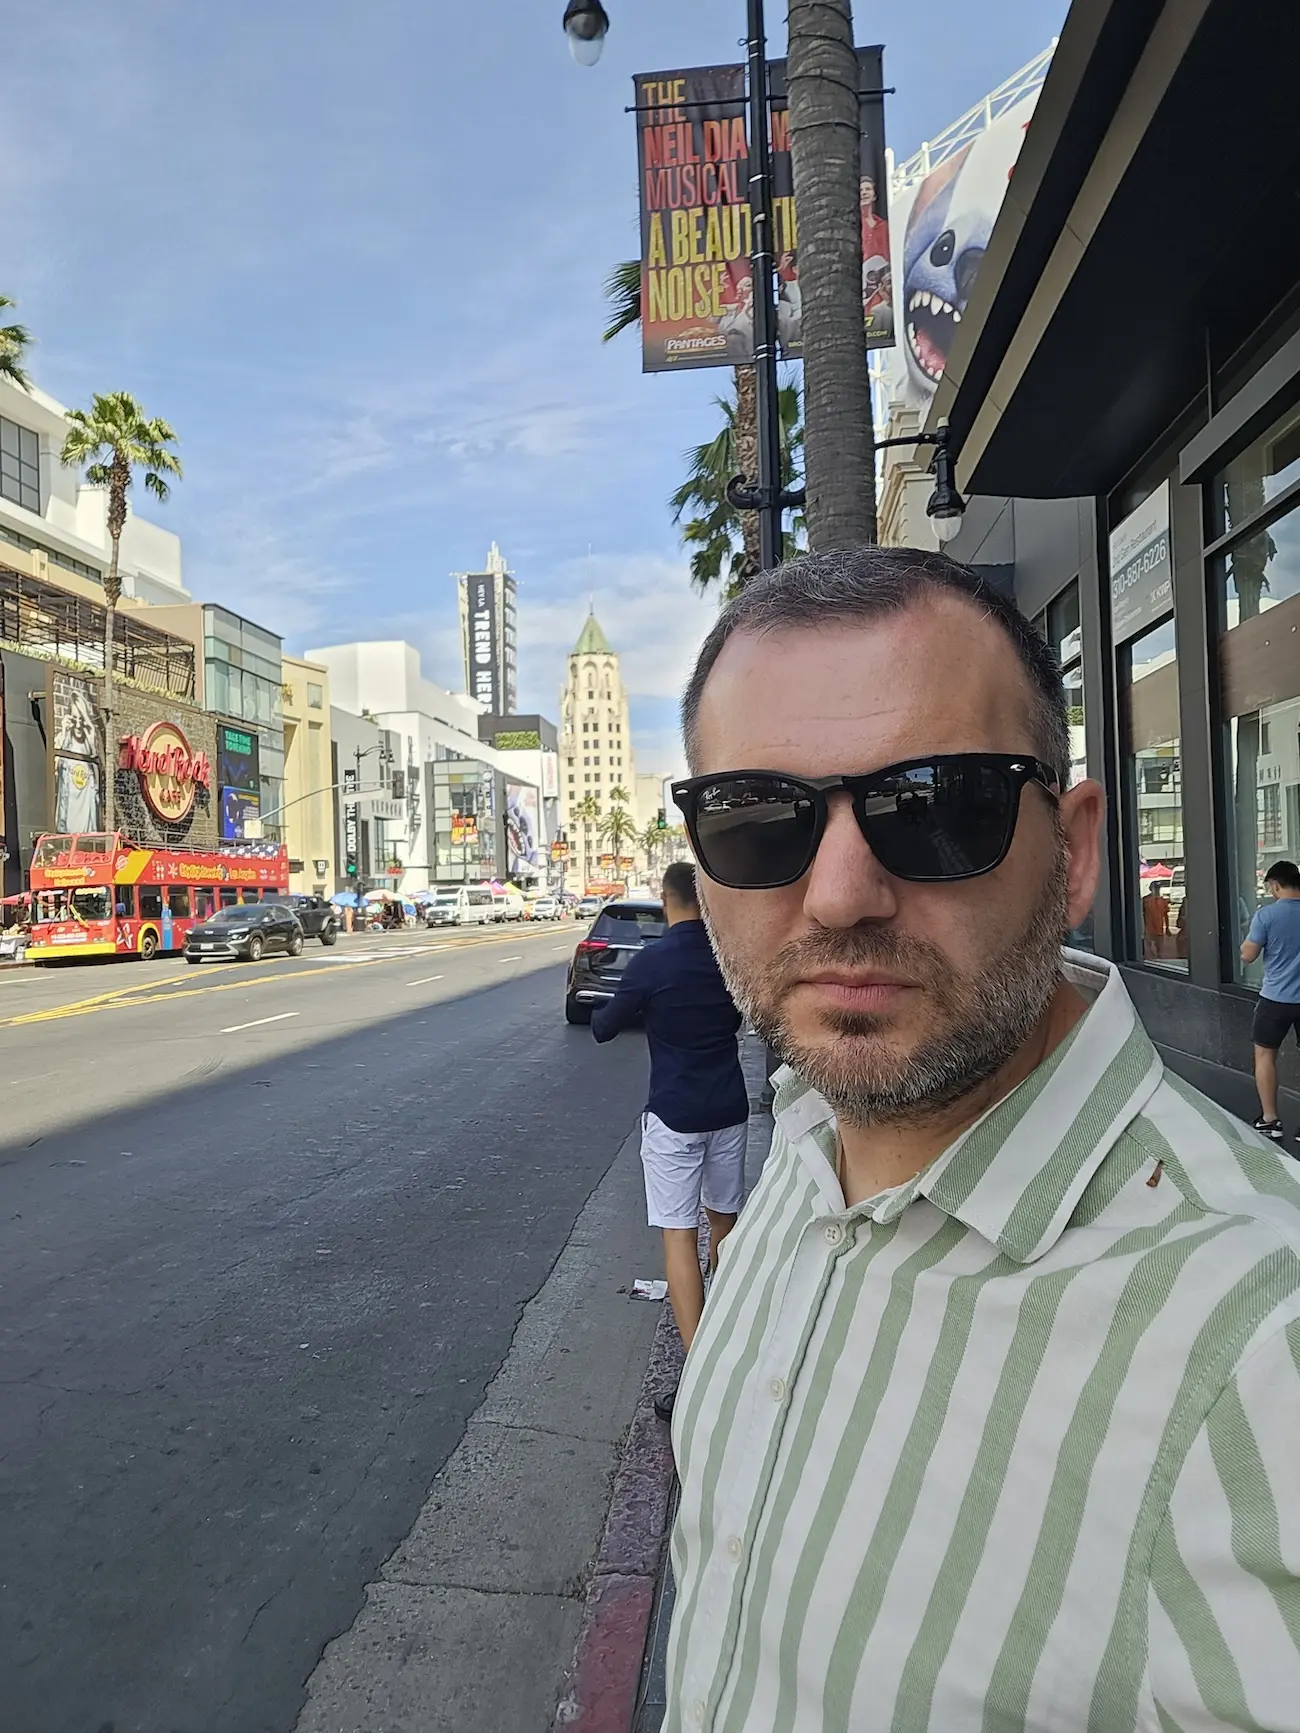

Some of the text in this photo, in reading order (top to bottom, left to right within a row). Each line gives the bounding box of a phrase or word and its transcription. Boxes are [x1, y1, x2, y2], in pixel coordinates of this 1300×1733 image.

[643, 79, 687, 125] THE
[644, 122, 700, 169] NEIL
[646, 161, 745, 211] MUSICAL
[648, 212, 667, 268] A
[648, 261, 727, 323] NOISE
[667, 334, 727, 351] PANTAGES
[1112, 538, 1167, 600] 310-887-6226
[474, 609, 492, 664] TREND
[120, 735, 211, 788] Hard Rock
[160, 789, 181, 804] CAFE
[345, 774, 357, 853] DOLBY THTRE
